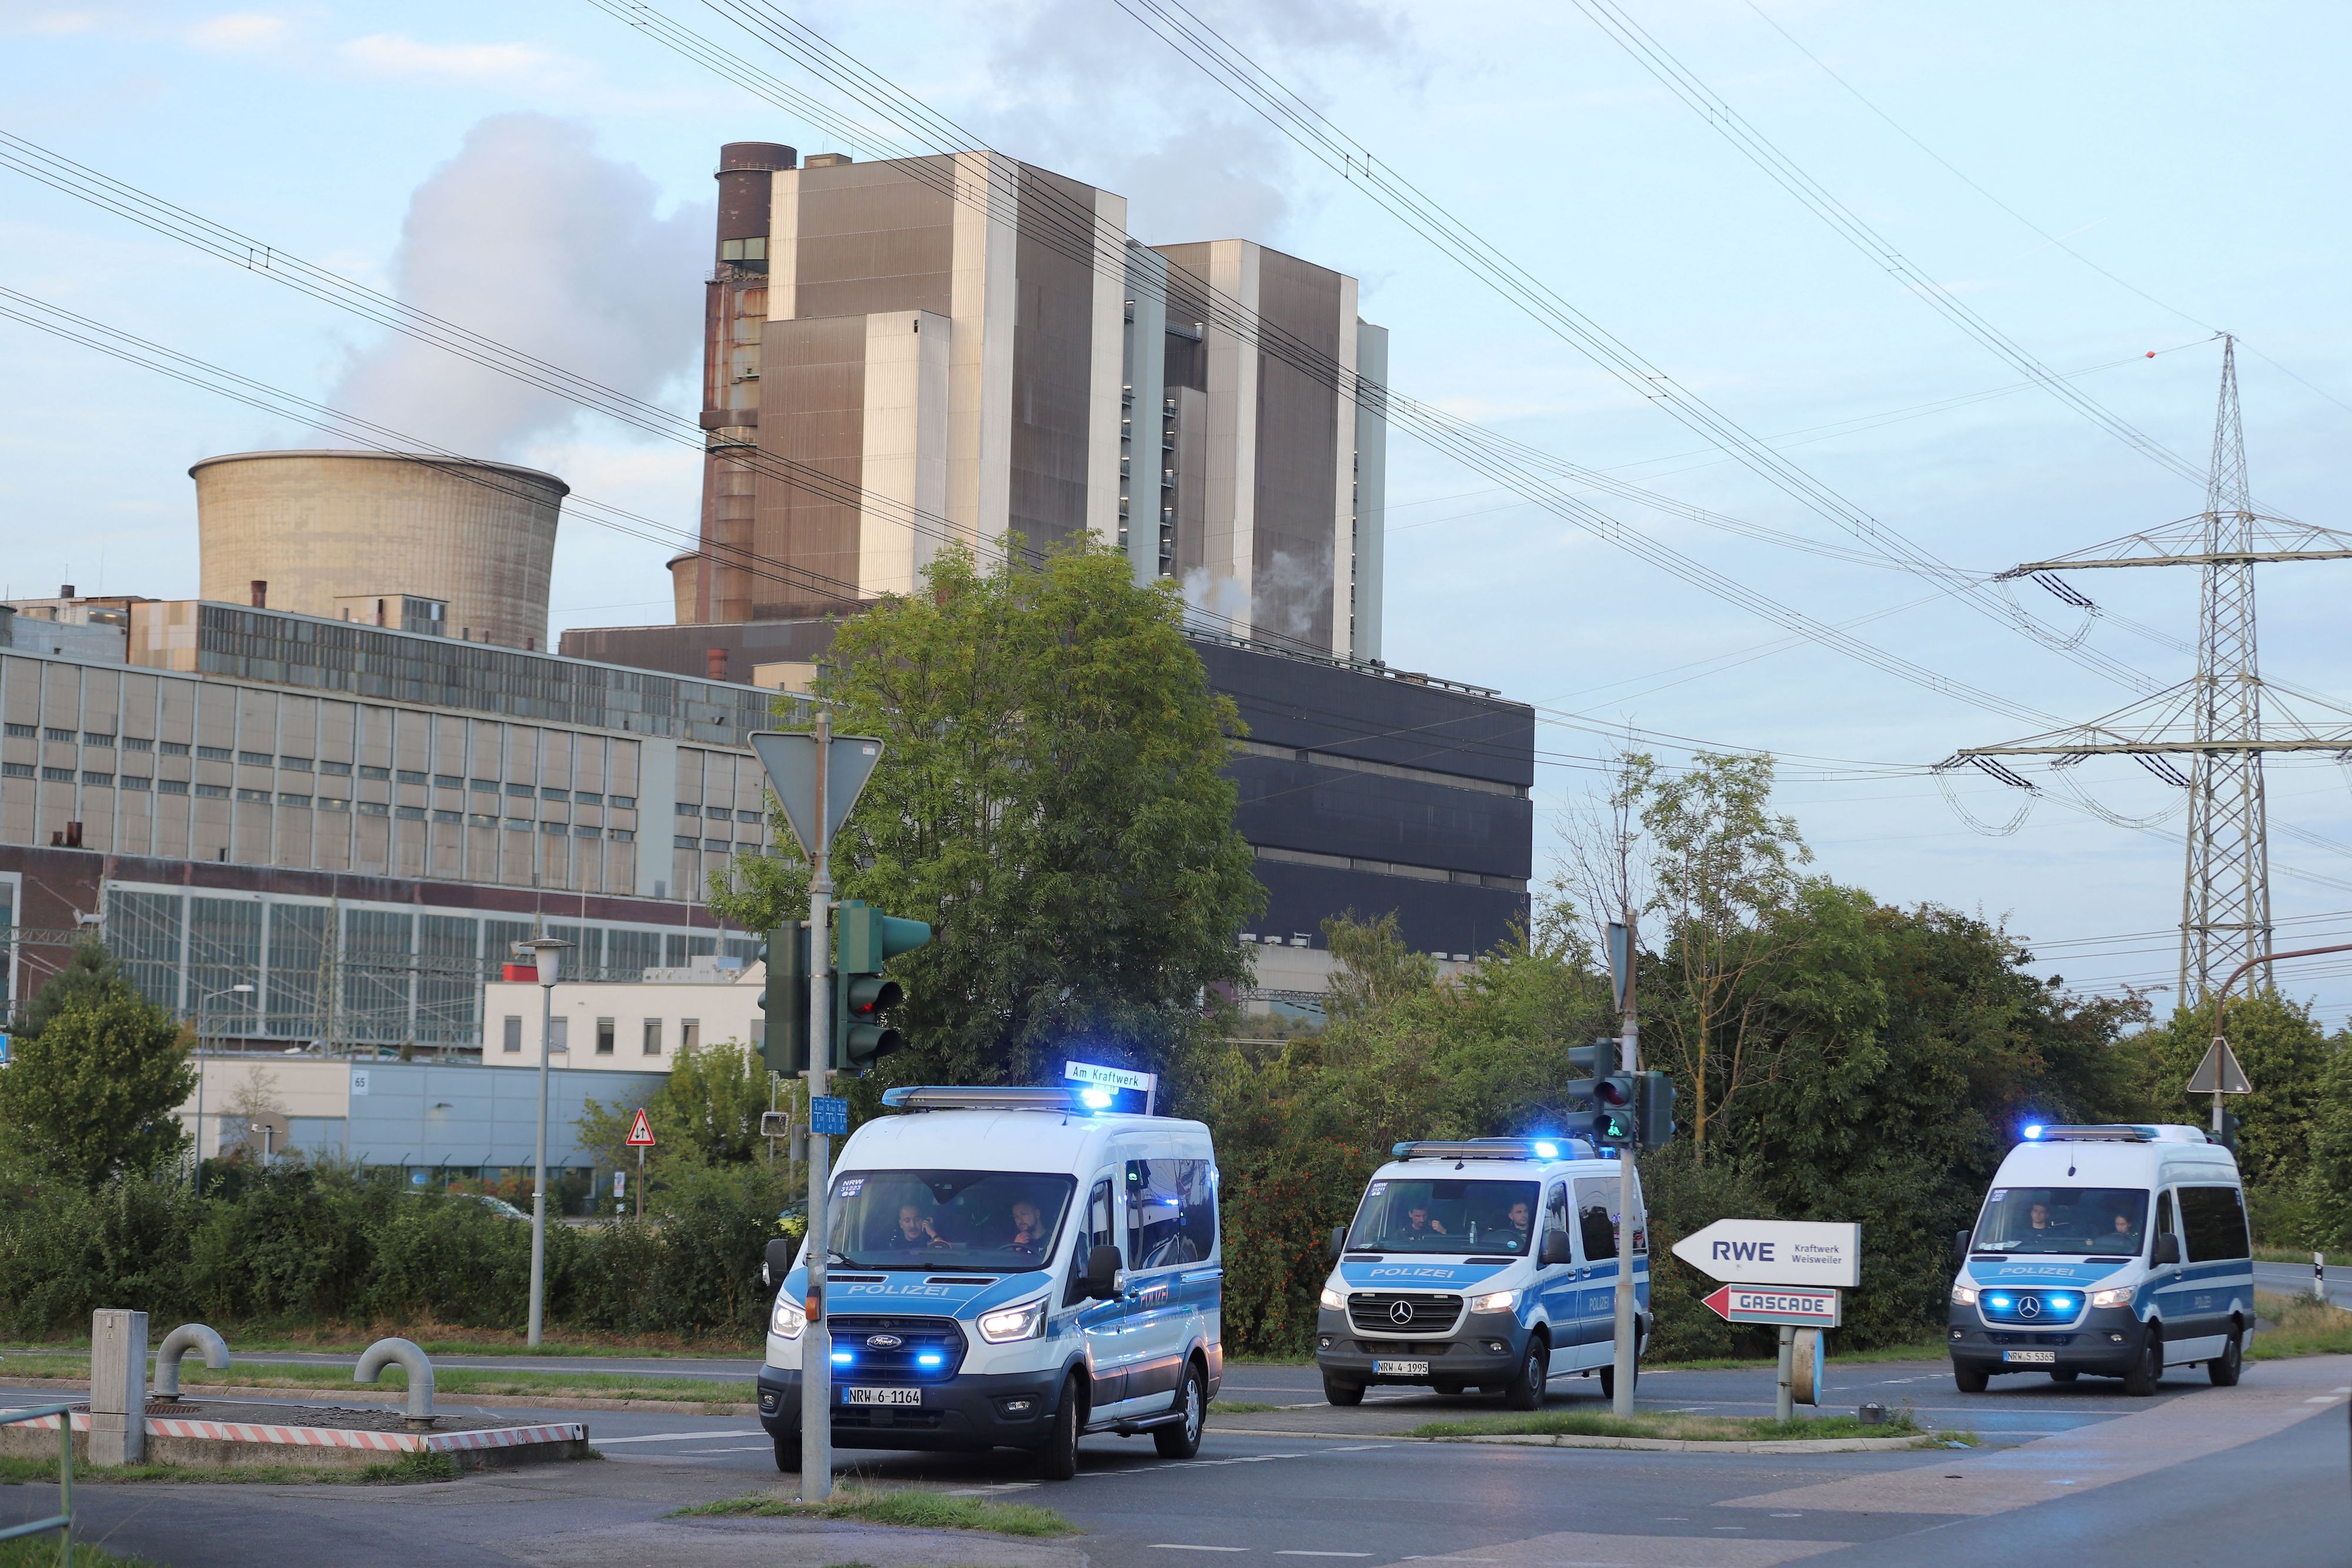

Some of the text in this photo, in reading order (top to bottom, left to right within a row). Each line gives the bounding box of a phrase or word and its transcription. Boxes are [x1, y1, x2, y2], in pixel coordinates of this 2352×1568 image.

[1073, 1066, 1138, 1086] Am Kraftwerk
[355, 1078, 365, 1087] 65
[1712, 1241, 1839, 1262] RWE Kraftwerk
[1792, 1255, 1842, 1264] Weisweiler
[1369, 1268, 1455, 1279] POLIZEI
[1999, 1267, 2075, 1276] POLIZEI
[847, 1285, 950, 1296] POLIZEI
[1140, 1284, 1168, 1308] POLIZEI
[1589, 1296, 1609, 1312] POLIZEI
[1740, 1295, 1825, 1312] GASCADE
[874, 1336, 893, 1345] Ford
[2007, 1352, 2022, 1360] NRW
[1378, 1362, 1427, 1373] NRW 4-1995
[850, 1389, 871, 1403] NRW
[878, 1390, 920, 1404] 6-1164
